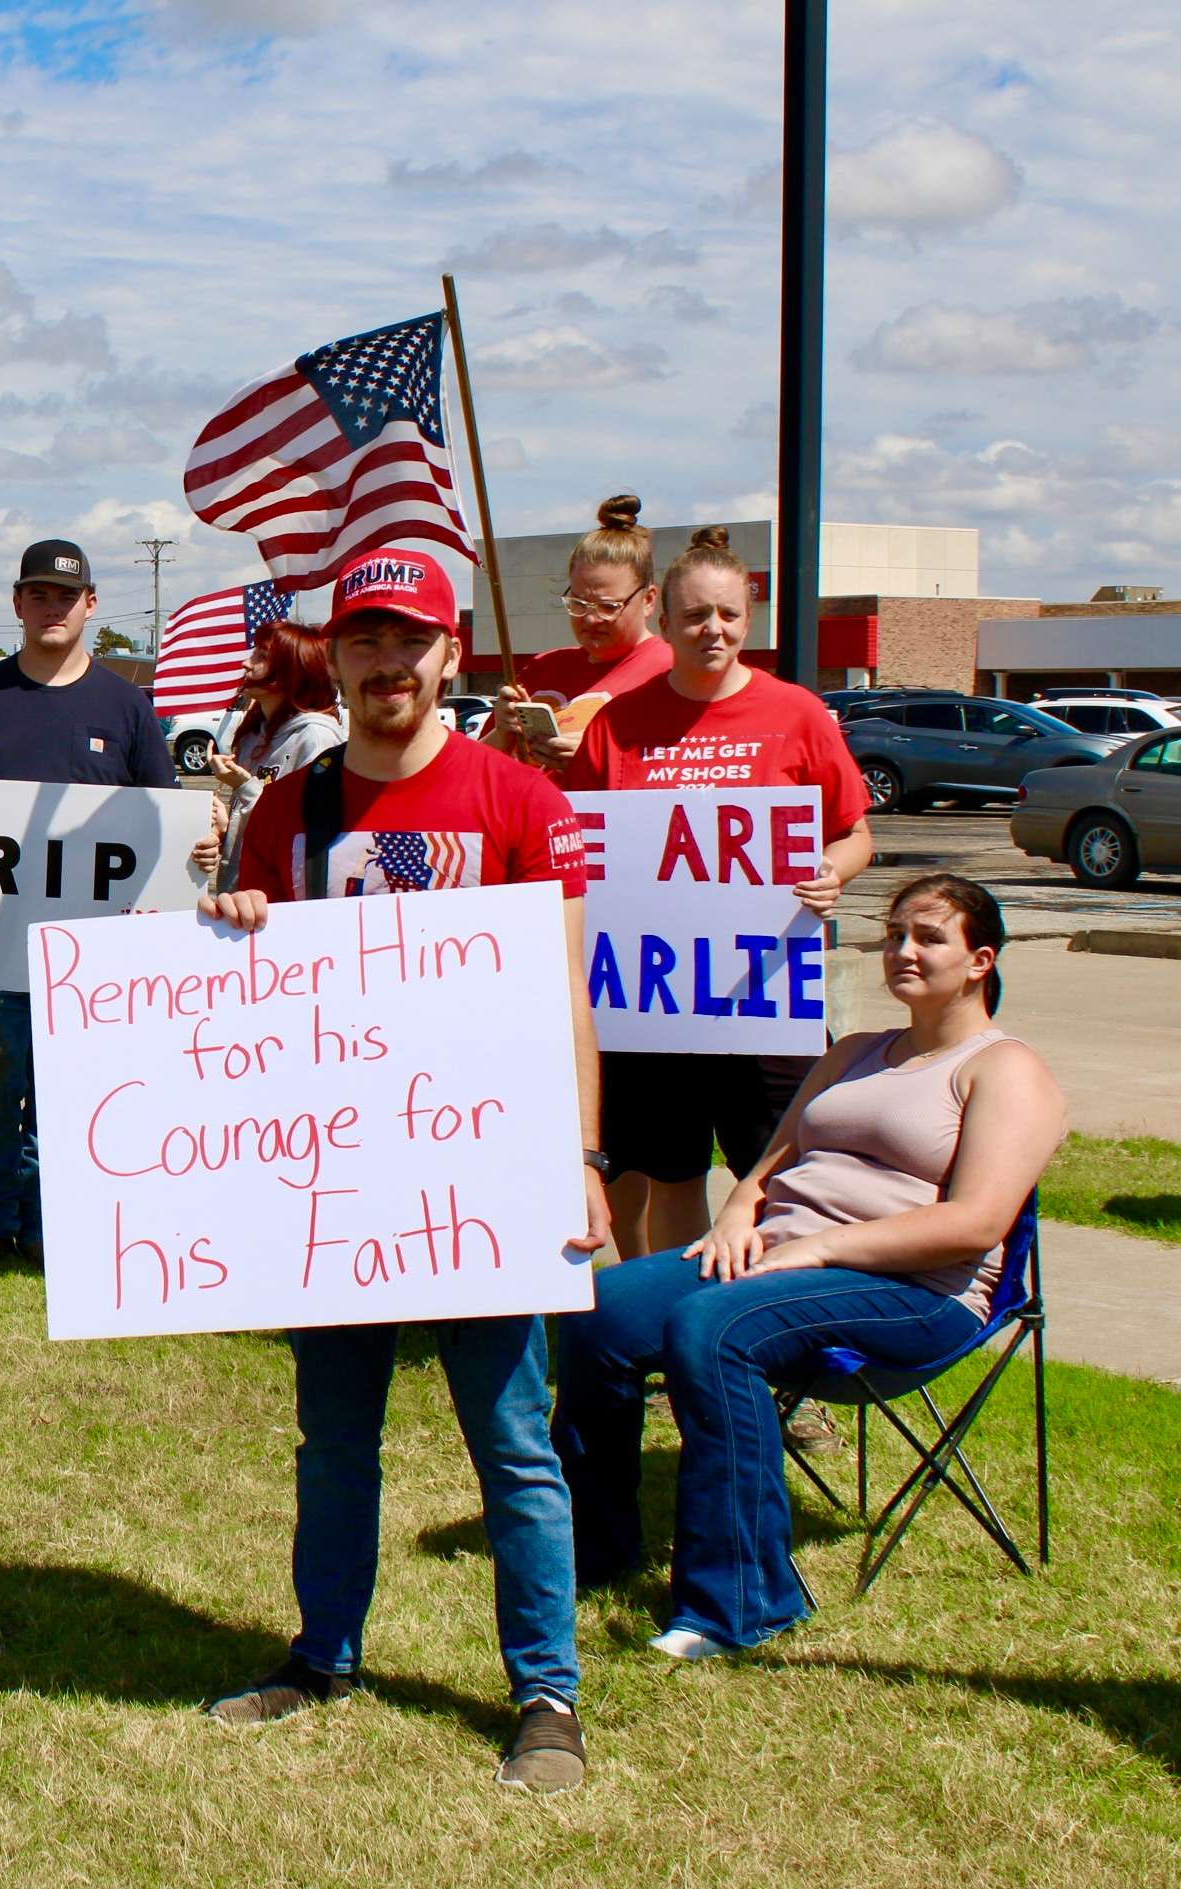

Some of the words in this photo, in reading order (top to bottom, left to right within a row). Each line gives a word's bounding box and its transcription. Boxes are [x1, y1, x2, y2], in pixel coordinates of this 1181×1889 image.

[58, 558, 77, 570] RM
[343, 561, 425, 595] TRUMP
[642, 746, 680, 762] LET
[681, 746, 716, 761] ME
[719, 742, 762, 758] GET
[646, 767, 679, 782] MY
[680, 764, 752, 781] SHOES
[657, 804, 815, 886] ARE
[40, 925, 334, 1036] Remember
[358, 895, 502, 996] Him
[588, 931, 824, 1020] ARLIE
[183, 1016, 284, 1080] for
[313, 1004, 389, 1064] his
[87, 1080, 361, 1190] Courage
[397, 1071, 505, 1141] for
[116, 1200, 228, 1310] his
[302, 1184, 501, 1289] Faith
